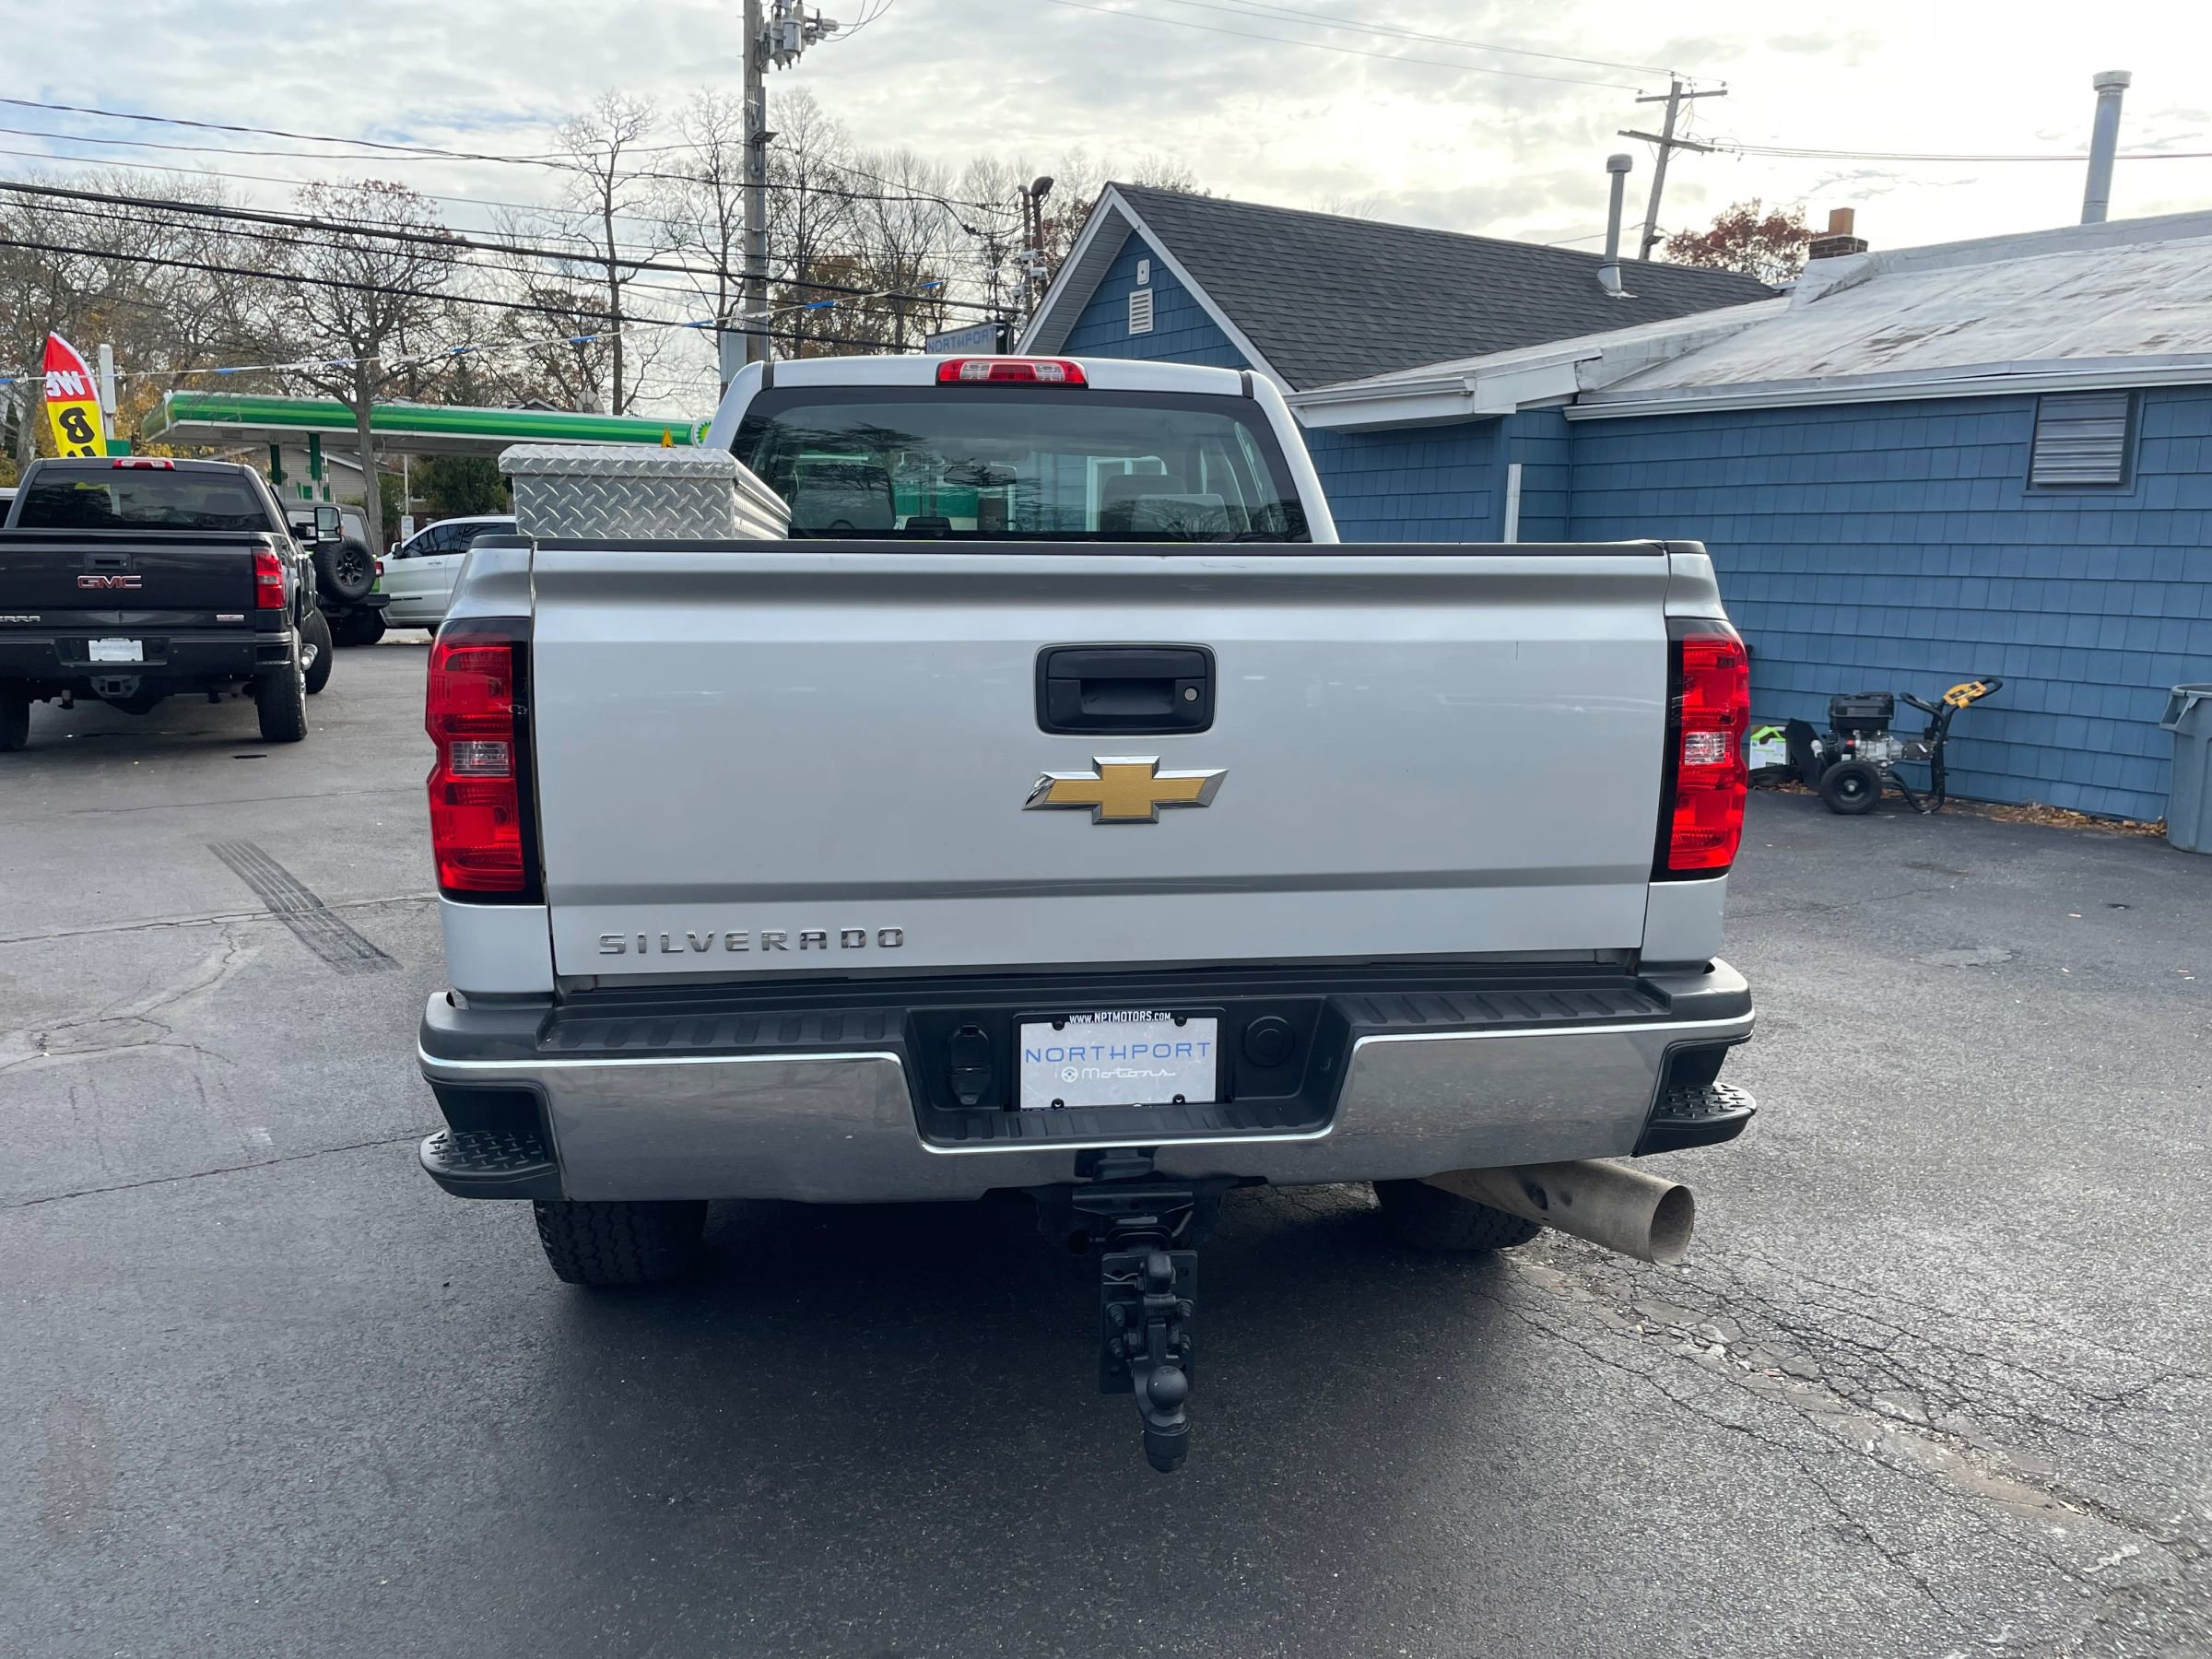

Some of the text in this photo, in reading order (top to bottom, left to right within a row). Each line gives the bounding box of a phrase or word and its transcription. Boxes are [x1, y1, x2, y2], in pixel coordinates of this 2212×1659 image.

[77, 575, 143, 589] GMC
[0, 615, 41, 623] RRA
[599, 927, 903, 955] SILVERADO
[1069, 1010, 1171, 1025] WWW.NPTMOTORS.COM
[1025, 1041, 1211, 1064] NORTHPORT
